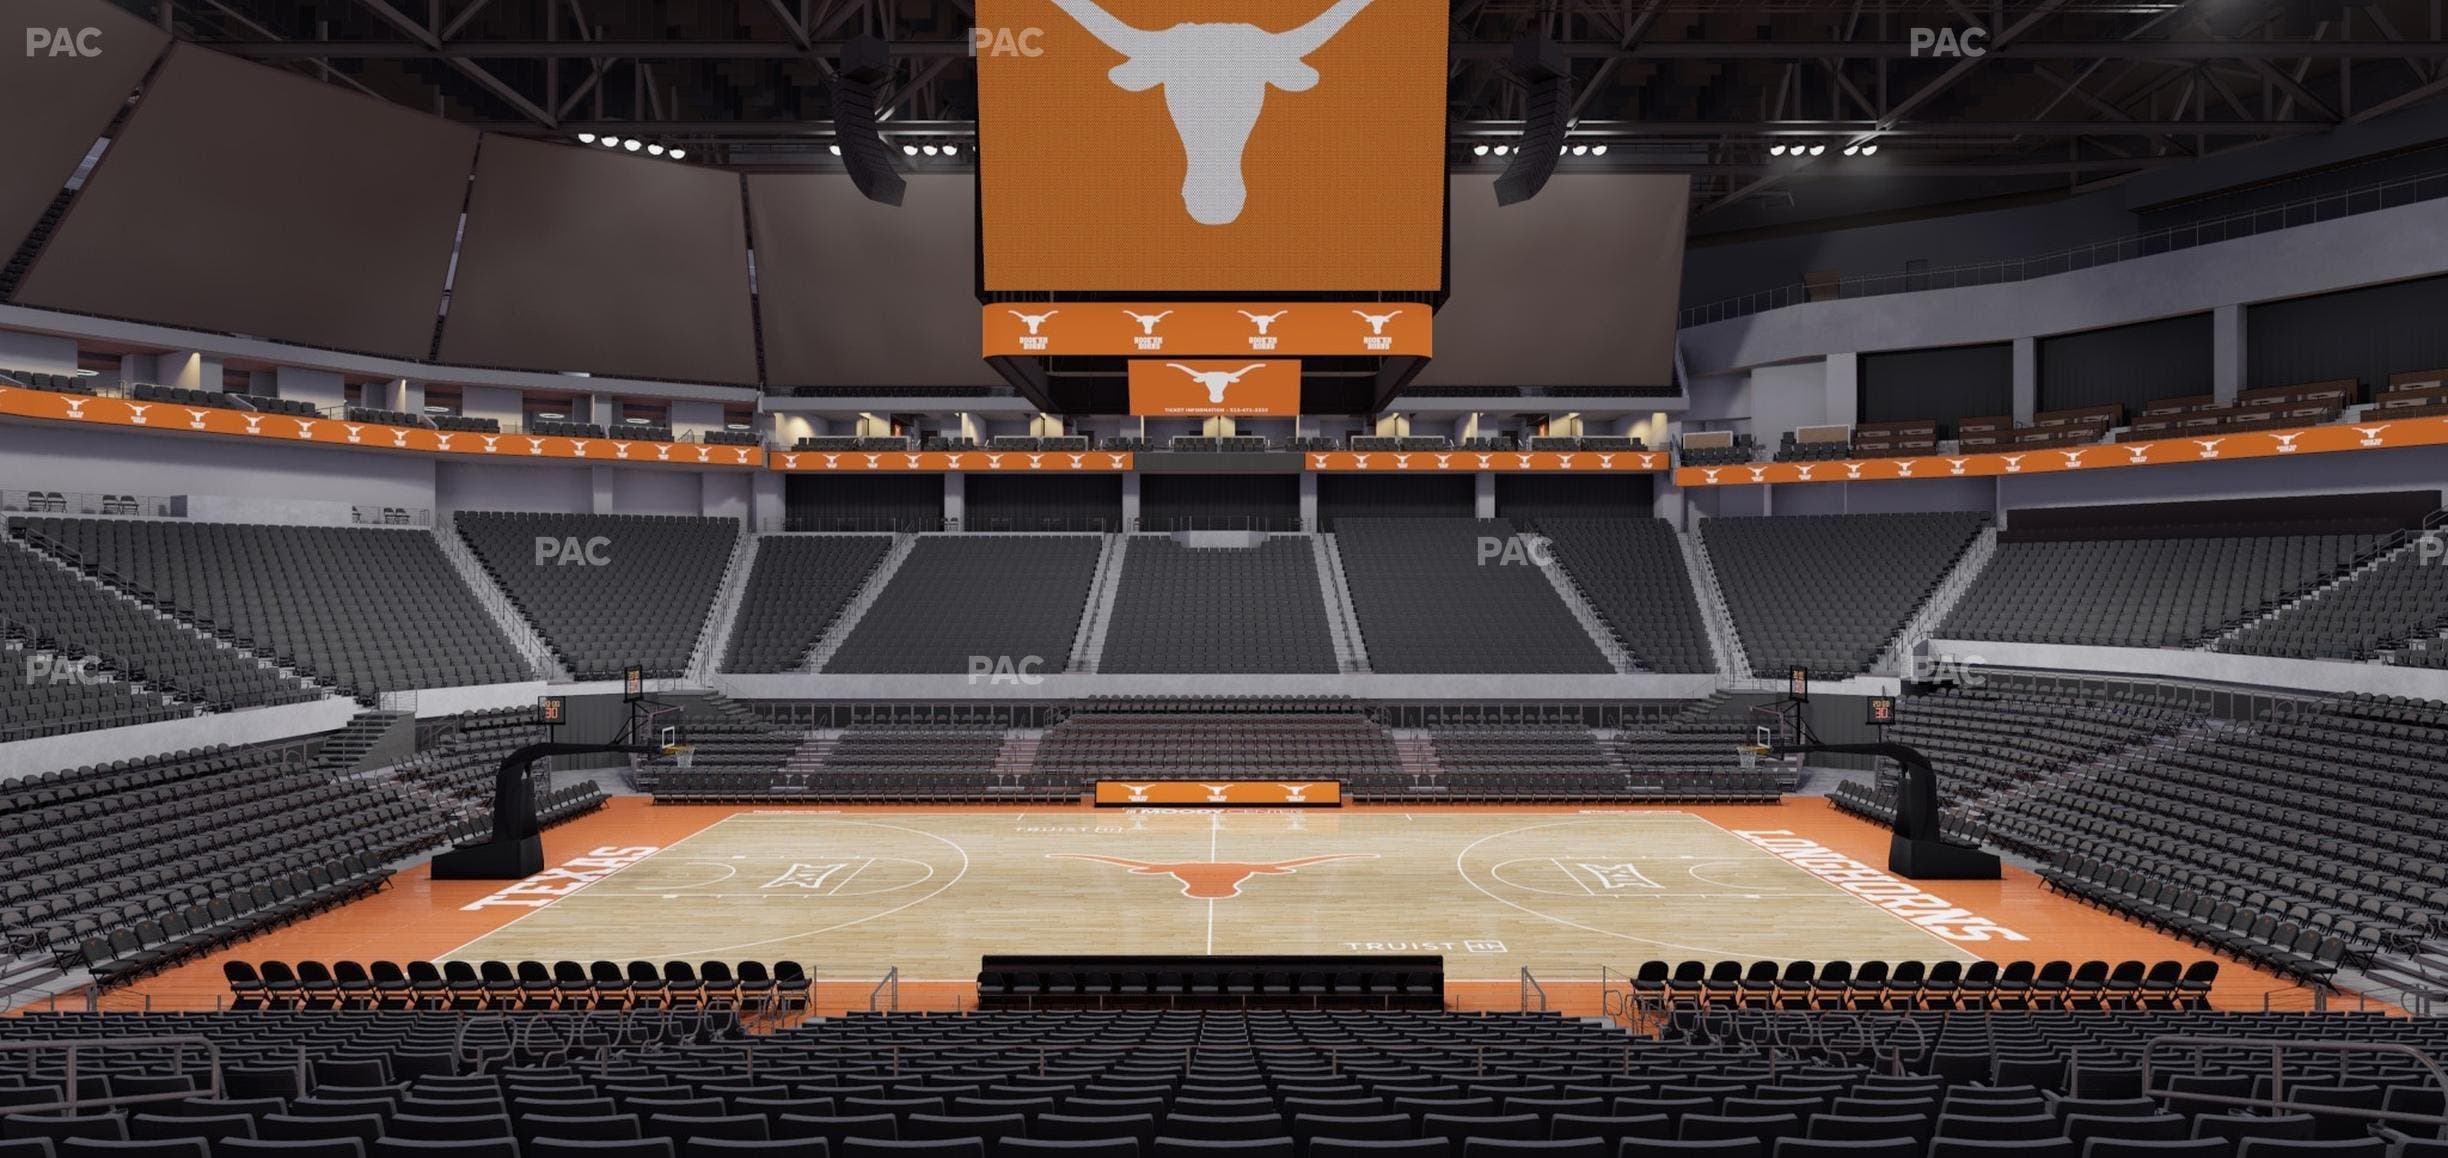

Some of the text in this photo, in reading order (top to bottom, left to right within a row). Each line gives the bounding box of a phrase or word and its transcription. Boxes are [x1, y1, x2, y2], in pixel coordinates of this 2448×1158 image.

[459, 846, 661, 911] TEXAS
[1731, 829, 2032, 942] LONGHORNS
[1343, 941, 1458, 951] TRUIST
